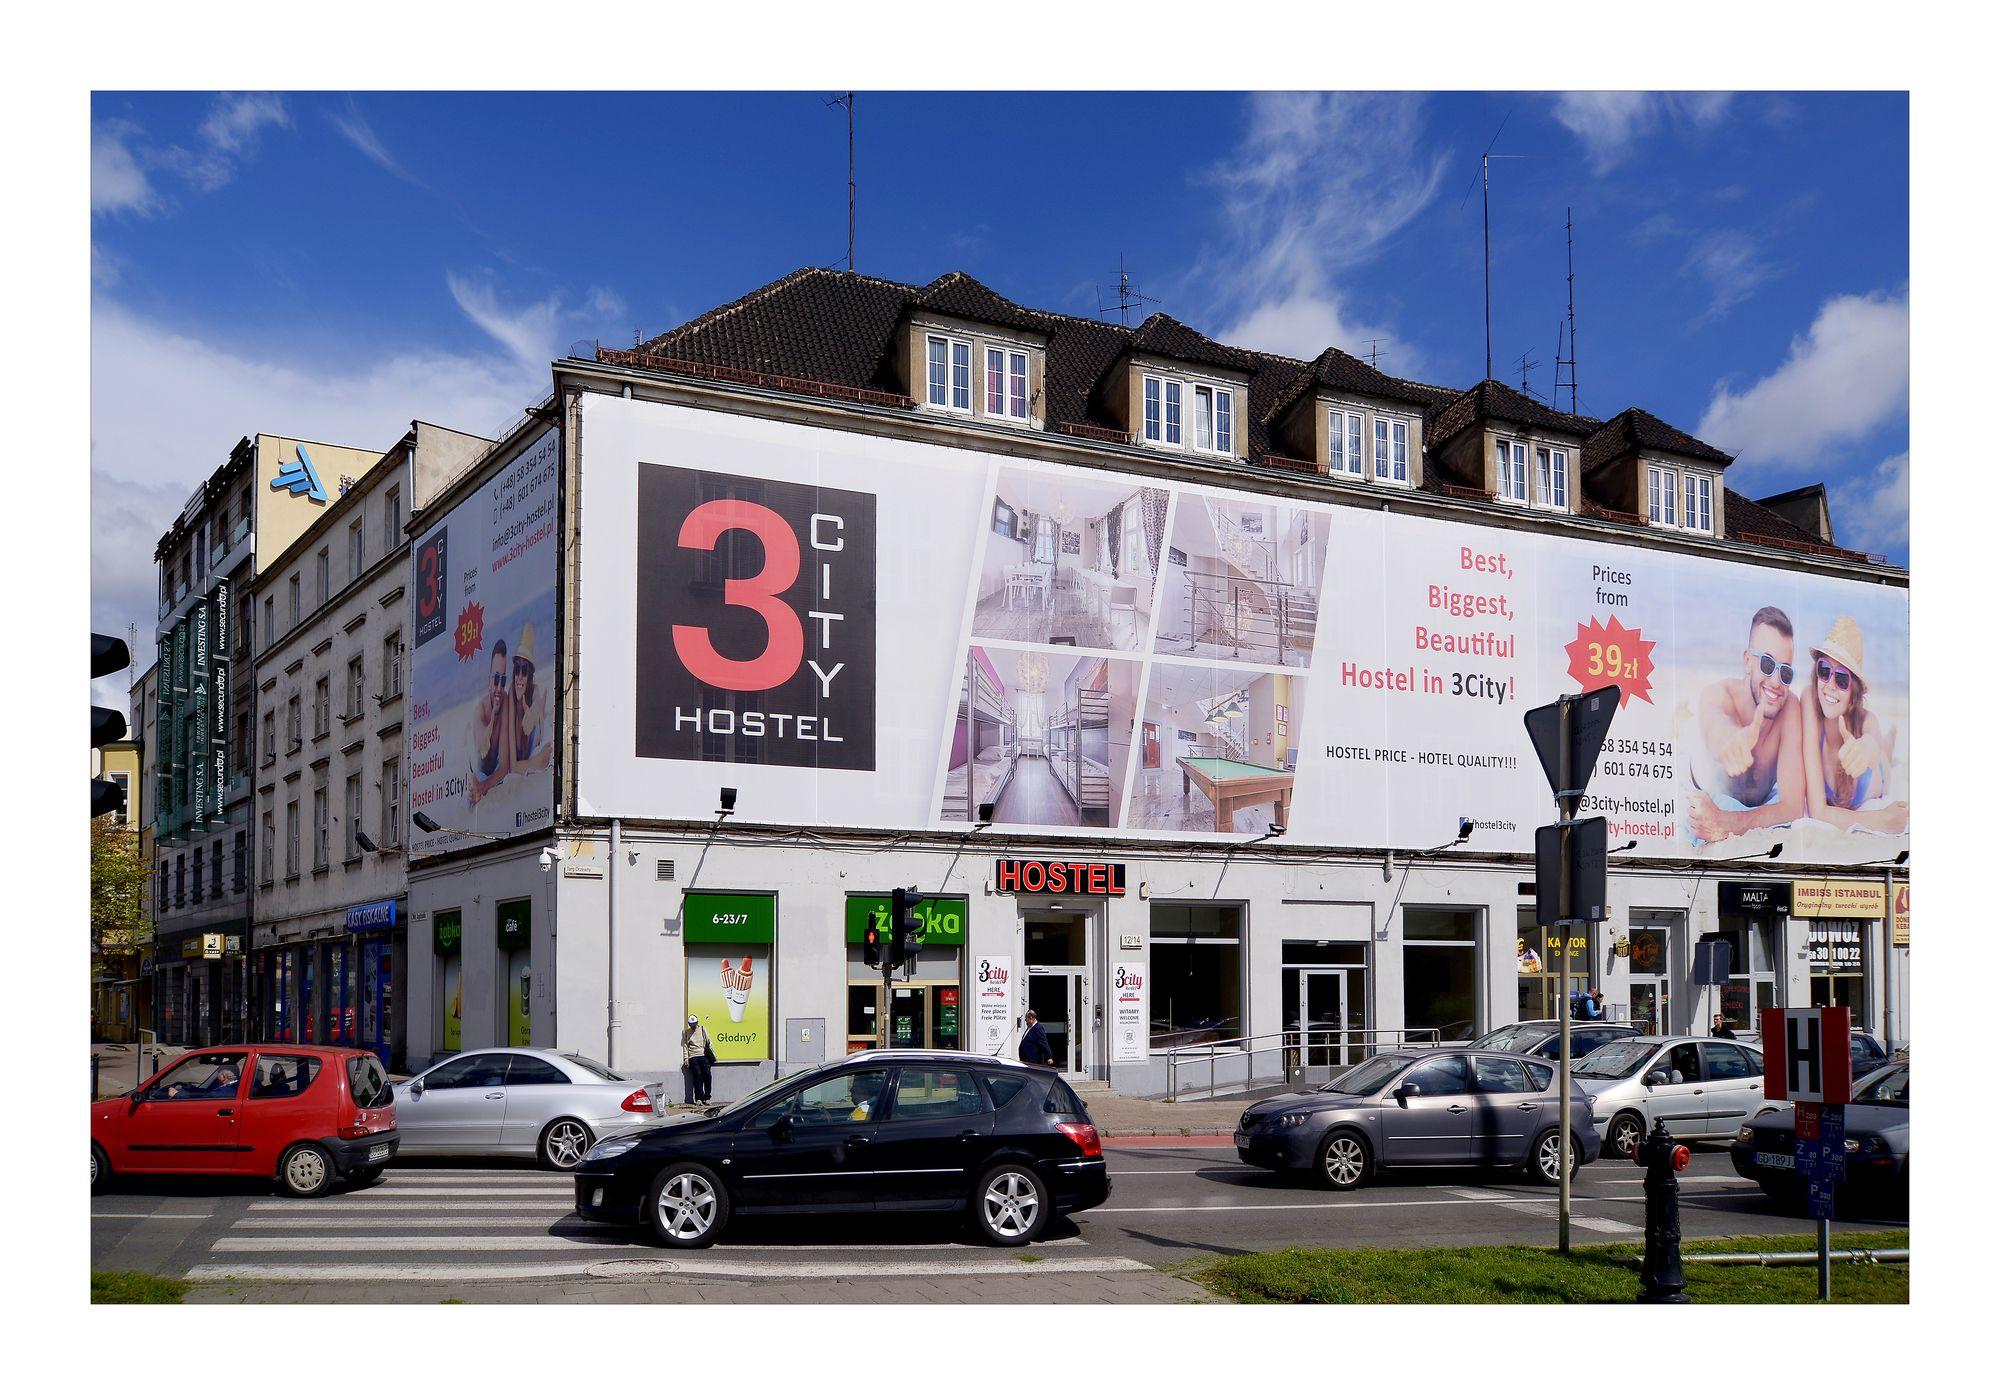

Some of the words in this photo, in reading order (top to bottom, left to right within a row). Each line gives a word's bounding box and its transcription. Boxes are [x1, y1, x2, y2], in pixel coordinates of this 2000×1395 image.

[500, 472, 515, 498] (+48)
[526, 455, 537, 475] 354
[538, 448, 546, 464] 54
[493, 493, 554, 552] info@3city-hostel.pl
[492, 516, 554, 572] www.3city-hostel.pl
[464, 567, 478, 582] Prices
[1460, 547, 1514, 580] Best,
[420, 546, 438, 617] 3
[1592, 565, 1632, 586] Prices
[672, 499, 804, 692] 3
[807, 513, 845, 698] CITY
[1428, 585, 1514, 621] Biggest,
[1596, 587, 1628, 607] from
[420, 616, 442, 636] HOSTEL
[198, 620, 206, 666] INVESTING
[1416, 626, 1515, 658] Beautiful
[1342, 662, 1414, 692] Hostel
[1424, 669, 1443, 694] in
[1451, 672, 1515, 704] 3City!
[414, 700, 430, 720] Best,
[675, 706, 844, 742] HOSTEL
[412, 727, 440, 751] Biggest,
[1618, 740, 1639, 754] 354
[1642, 742, 1656, 756] 54
[1660, 742, 1672, 757] 54
[196, 762, 204, 775] S.A.
[412, 750, 444, 780] Beautiful
[1326, 746, 1370, 760] HOSTEL
[1374, 748, 1406, 762] PRICE
[1418, 752, 1454, 766] HOTEL
[1457, 754, 1516, 769] QUALITY!!!
[1604, 762, 1625, 776] 601
[1628, 763, 1650, 778] 674
[1652, 764, 1673, 779] 675
[196, 778, 204, 823] INVESTING
[412, 785, 434, 808] Hostel
[436, 784, 442, 802] in
[444, 773, 468, 797] 3City!
[1000, 861, 1126, 894] HOSTEL
[1742, 892, 1768, 902] MALTA
[1798, 888, 1832, 898] IMBISS
[1835, 890, 1882, 898] ISTANBUL
[1796, 902, 1832, 910] Oryginalny
[348, 911, 362, 928] KASY
[712, 914, 748, 925] 6-23/7
[876, 904, 960, 934] żka
[1124, 936, 1141, 945] 12/14
[1548, 937, 1586, 948] KATOR
[717, 1032, 756, 1044] Głodny?
[1787, 1018, 1821, 1093] H
[1823, 1146, 1830, 1158] P
[1810, 1184, 1818, 1195] P
